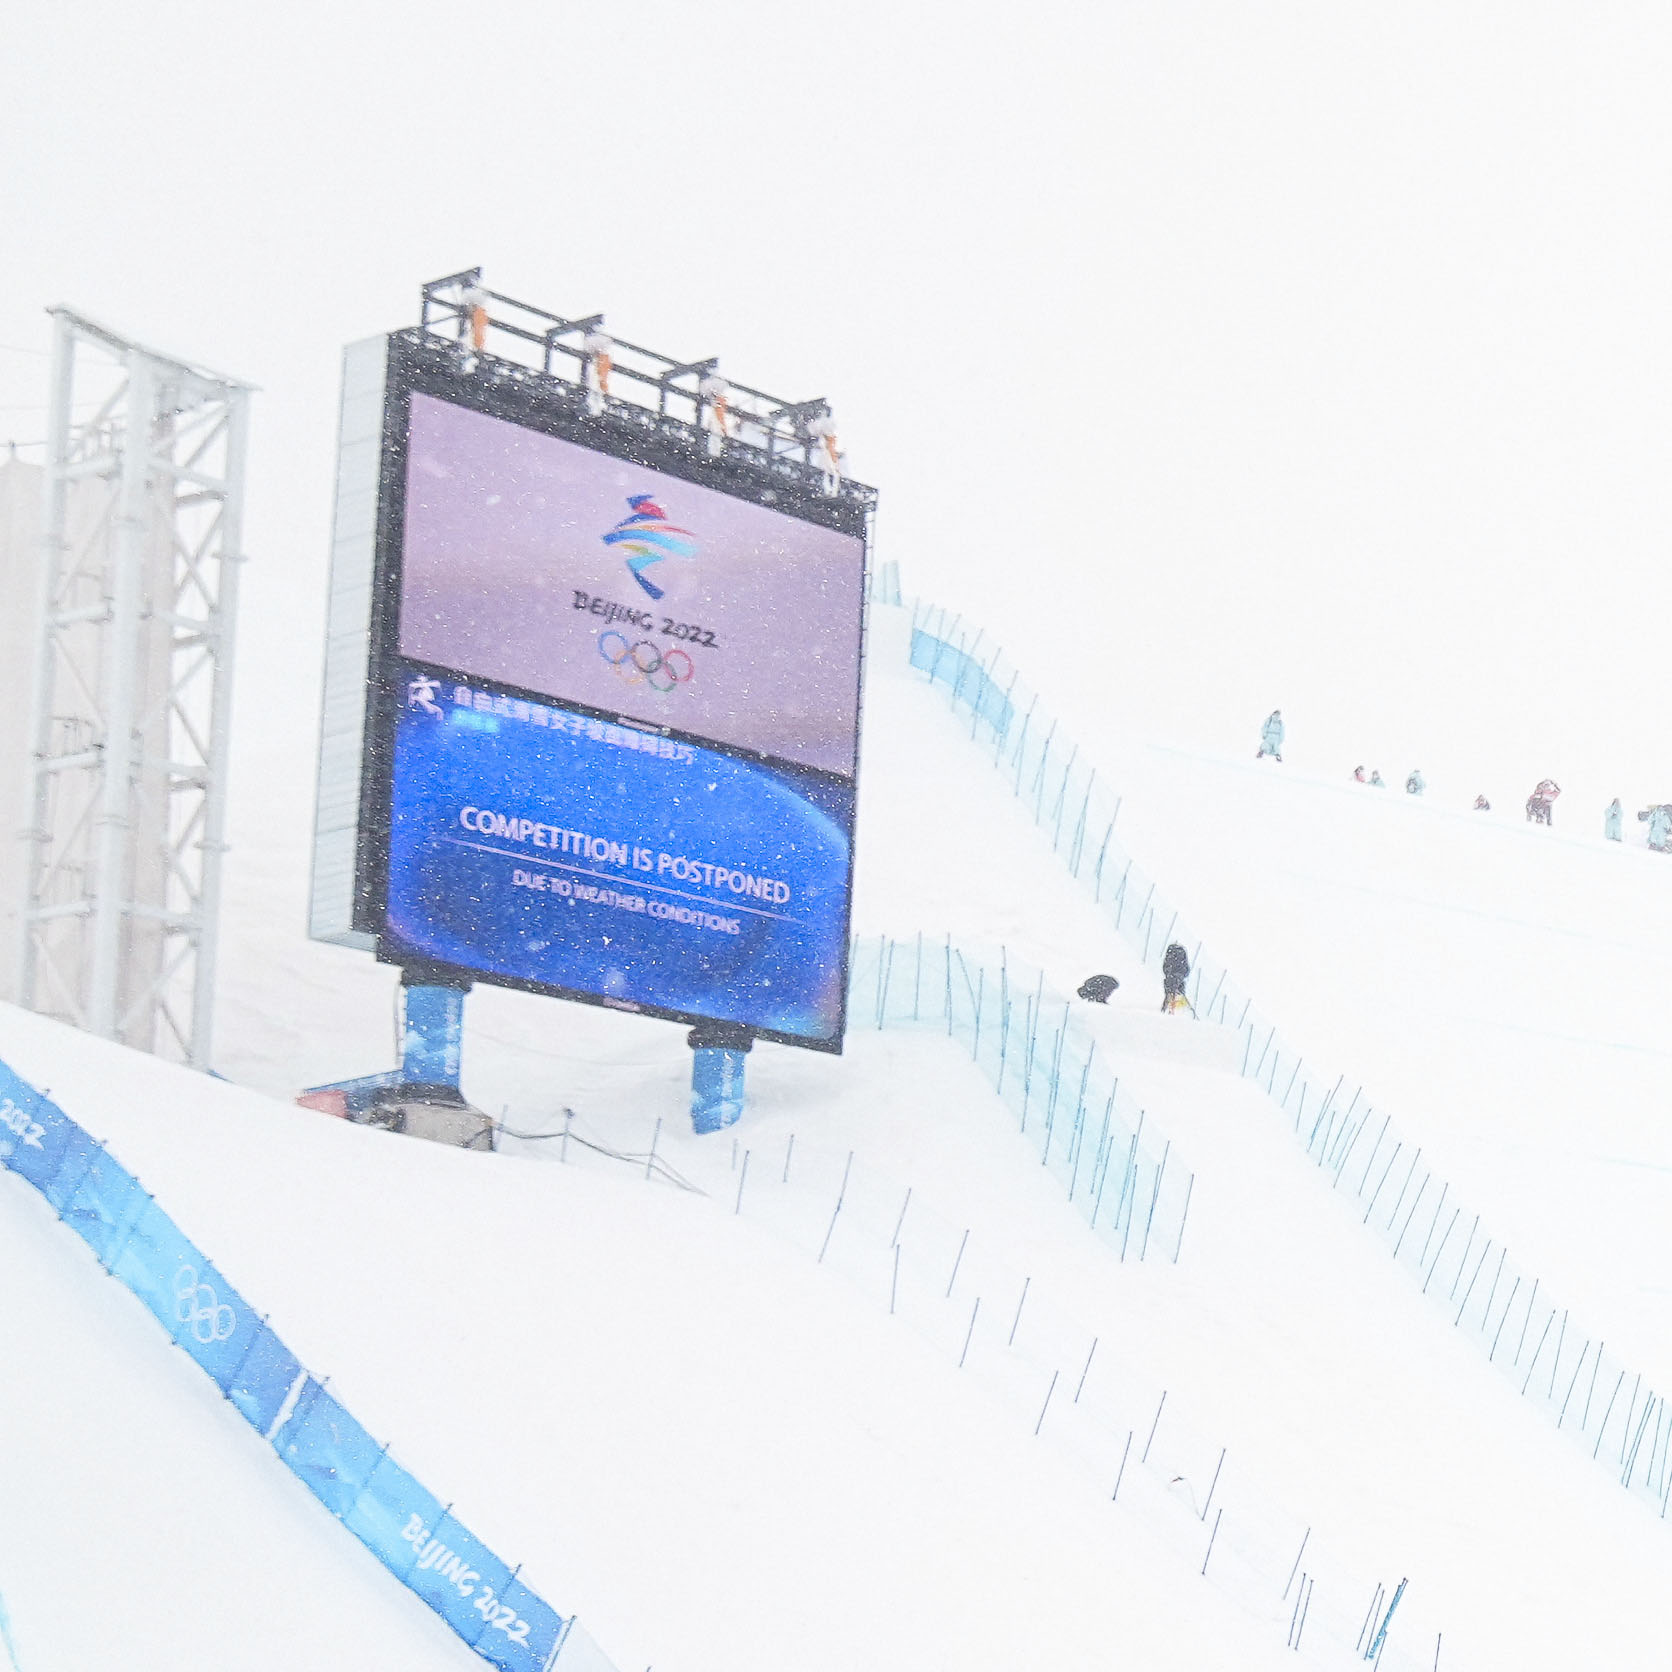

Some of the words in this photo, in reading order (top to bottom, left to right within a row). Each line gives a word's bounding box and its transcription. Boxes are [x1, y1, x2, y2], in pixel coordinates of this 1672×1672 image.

[573, 590, 653, 631] BEIJING
[660, 617, 718, 649] 2022
[459, 806, 629, 866] COMPETITION
[632, 846, 653, 872] IS
[657, 854, 791, 904] POSTPONED
[511, 869, 547, 891] DUE
[549, 879, 572, 897] TO
[647, 900, 741, 935] CONDITIONS
[402, 1512, 481, 1597] BEIJING
[473, 1586, 531, 1648] 2022
